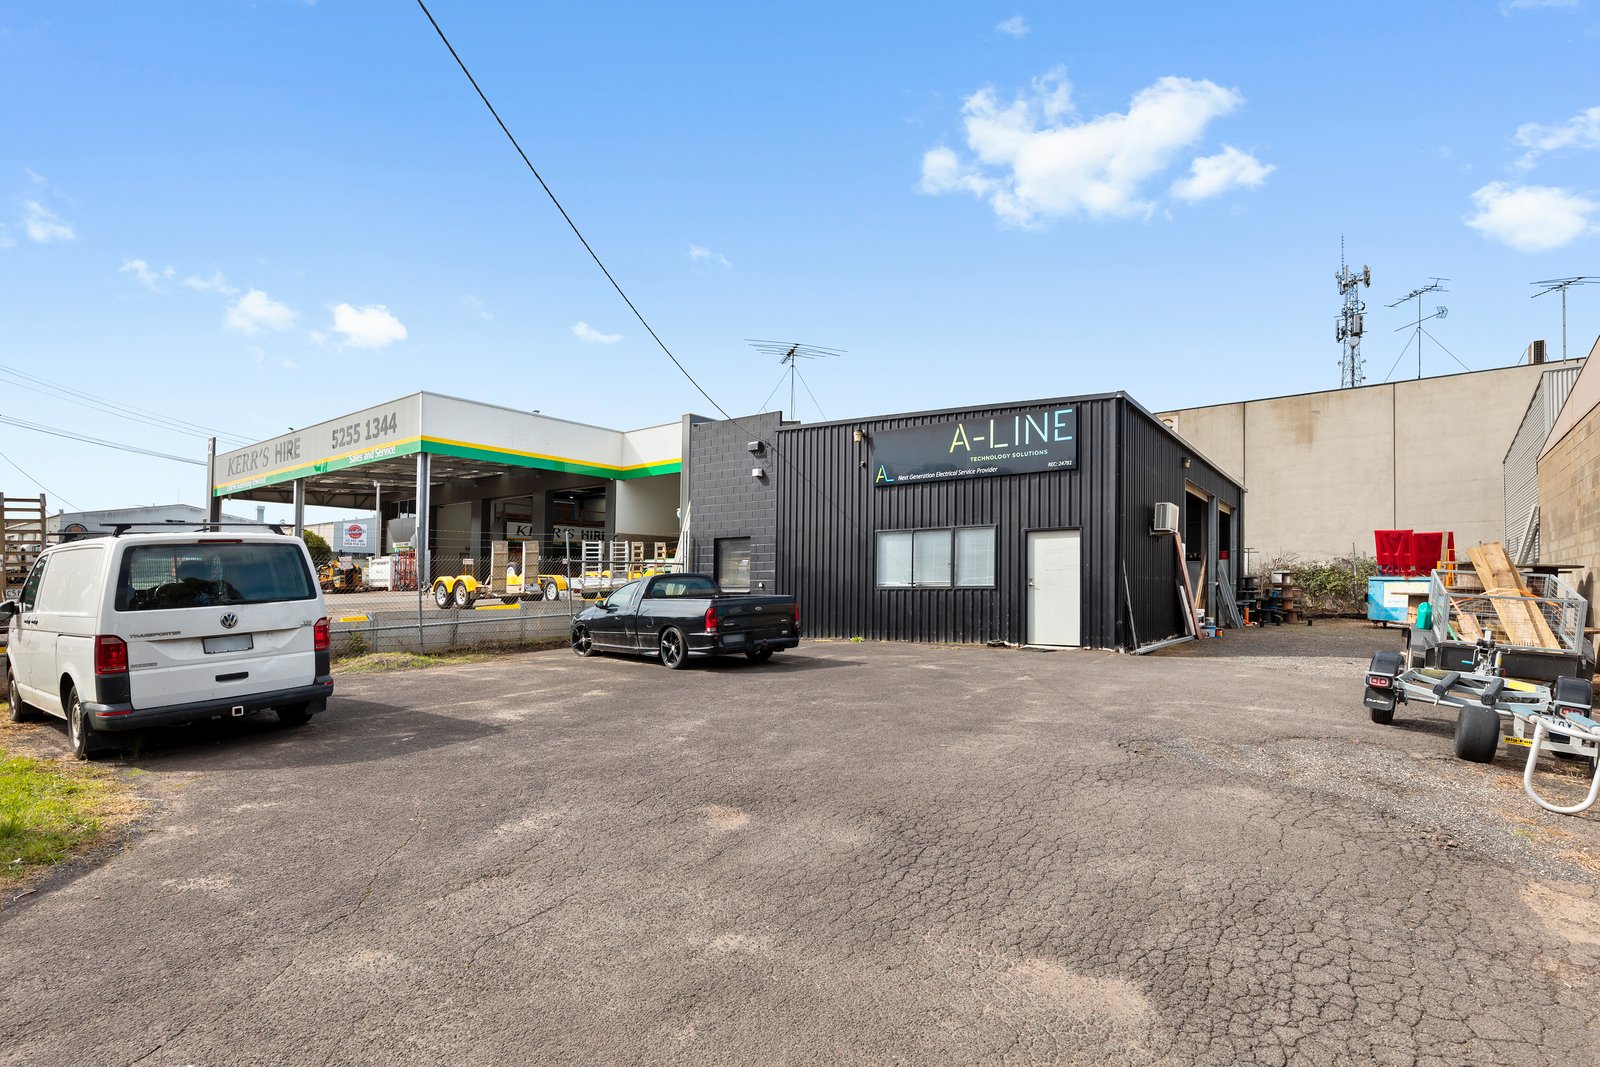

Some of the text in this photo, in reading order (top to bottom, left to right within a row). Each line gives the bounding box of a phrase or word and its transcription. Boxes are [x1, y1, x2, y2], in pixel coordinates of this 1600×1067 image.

[331, 412, 398, 449] 5255 1344
[949, 408, 1073, 453] A-LINE
[227, 437, 301, 477] KERR'S HIRE
[348, 446, 396, 464] Sales and Service
[970, 449, 1048, 462] TECHNOLOGY SOLUTIONS
[875, 464, 895, 483] AL
[909, 471, 936, 480] Generation
[935, 469, 958, 478] Electrical
[957, 468, 976, 476] Service
[976, 466, 998, 475] Provider
